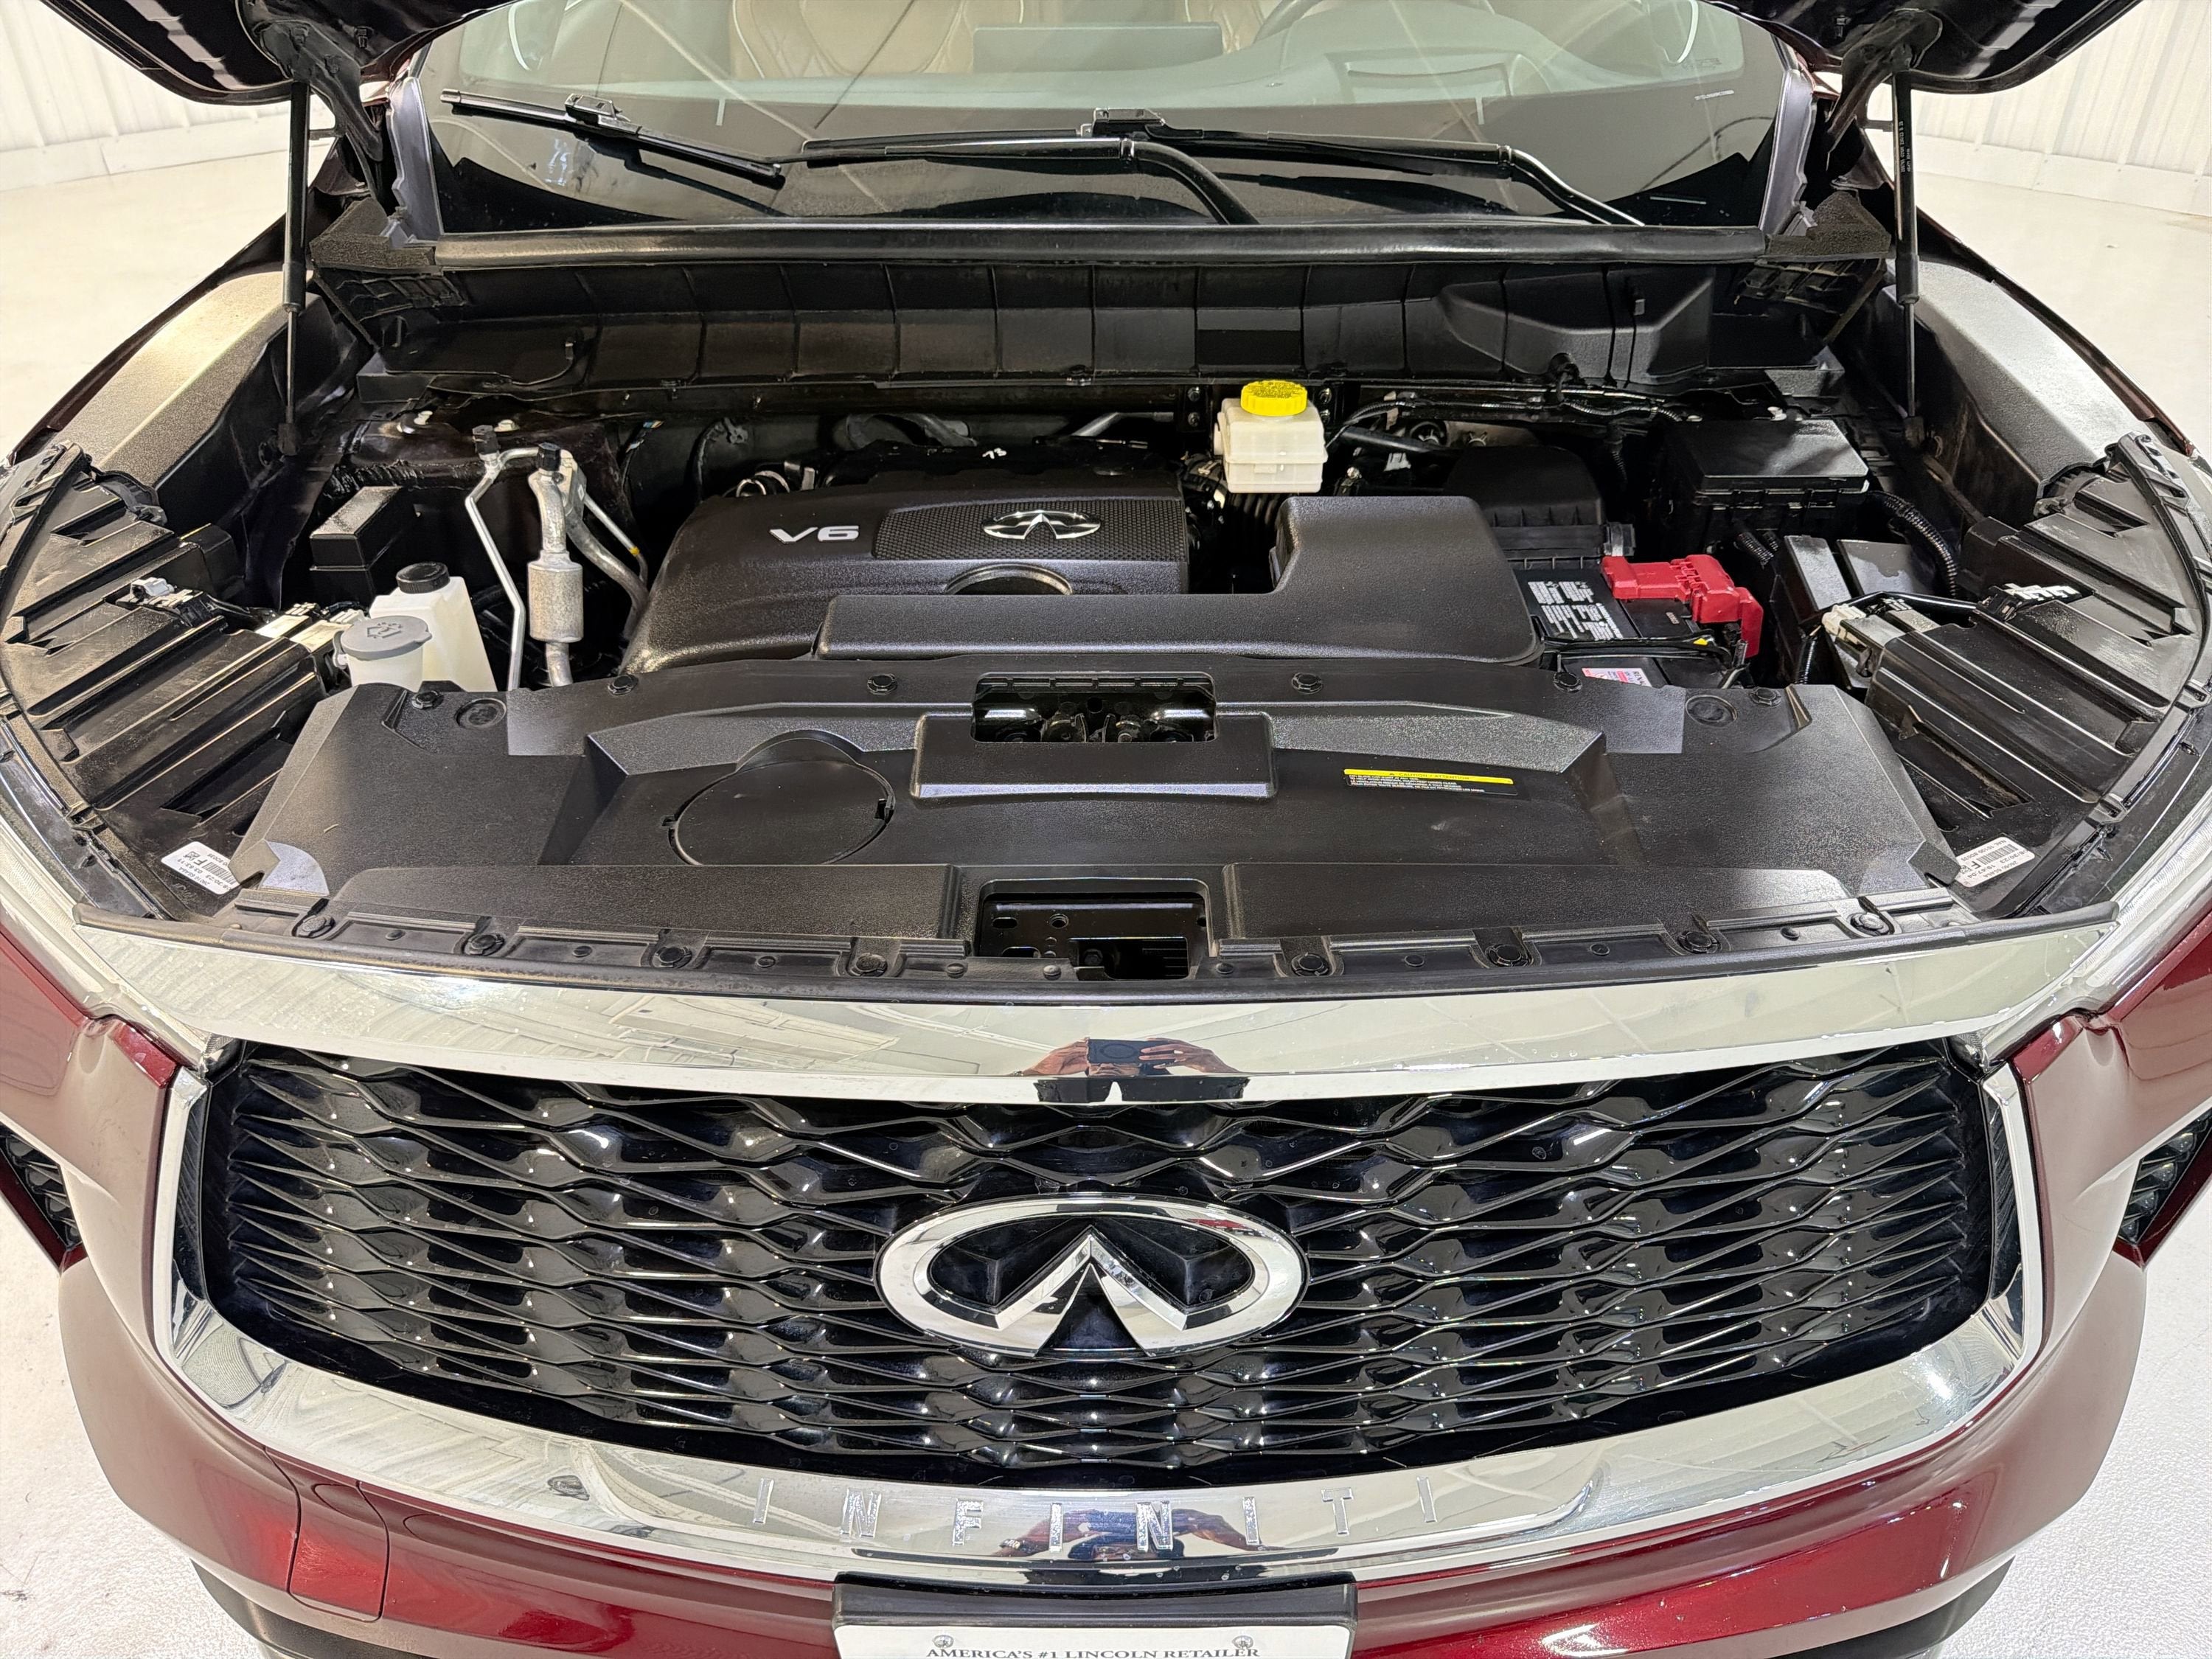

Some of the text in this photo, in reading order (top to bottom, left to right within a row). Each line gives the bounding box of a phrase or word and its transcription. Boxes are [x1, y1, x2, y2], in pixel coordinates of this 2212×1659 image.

[769, 525, 860, 544] V6
[192, 857, 208, 866] F
[1966, 860, 1981, 869] F
[753, 1475, 1438, 1553] INFINITI
[926, 1649, 1260, 1659] AMERICA'S #1 LINCOLN RETAILER
